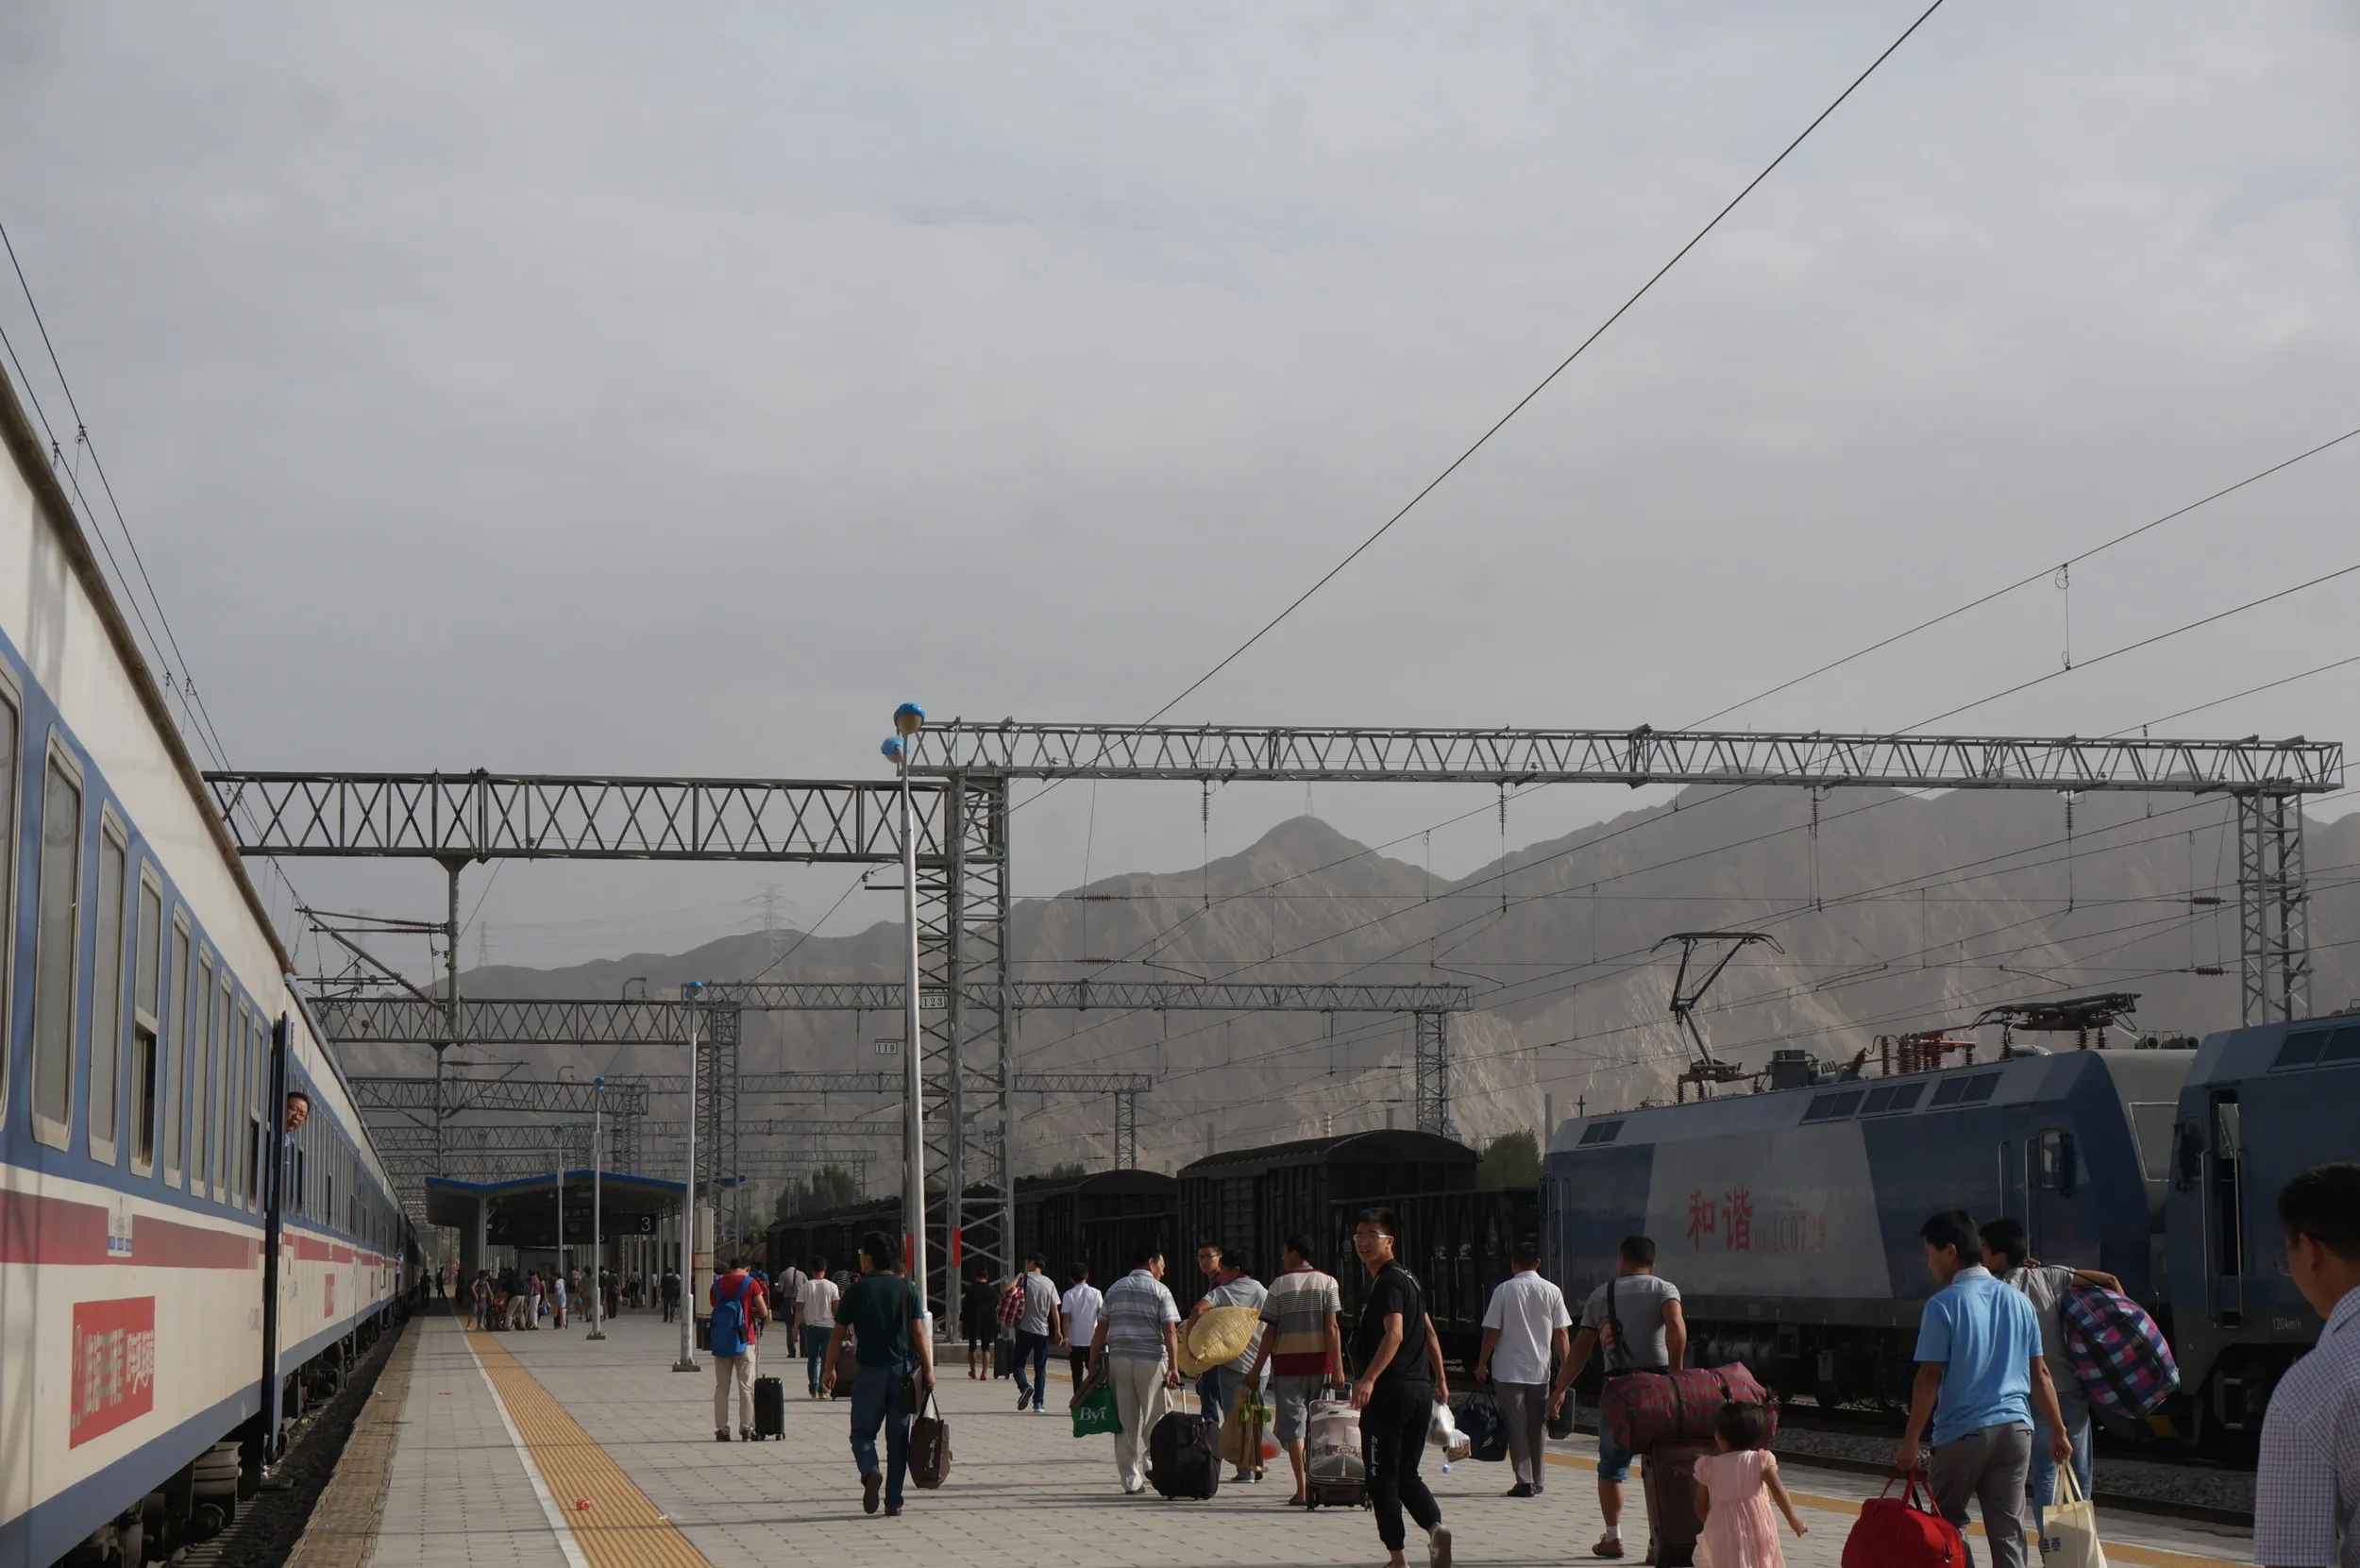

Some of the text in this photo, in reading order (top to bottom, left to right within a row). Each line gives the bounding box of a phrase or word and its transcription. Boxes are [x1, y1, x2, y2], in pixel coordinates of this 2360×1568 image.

[923, 997, 943, 1007] 123
[877, 1044, 895, 1053] 119
[498, 1218, 509, 1234] 2
[641, 1217, 651, 1232] 3
[1686, 1186, 1754, 1252] 和谐
